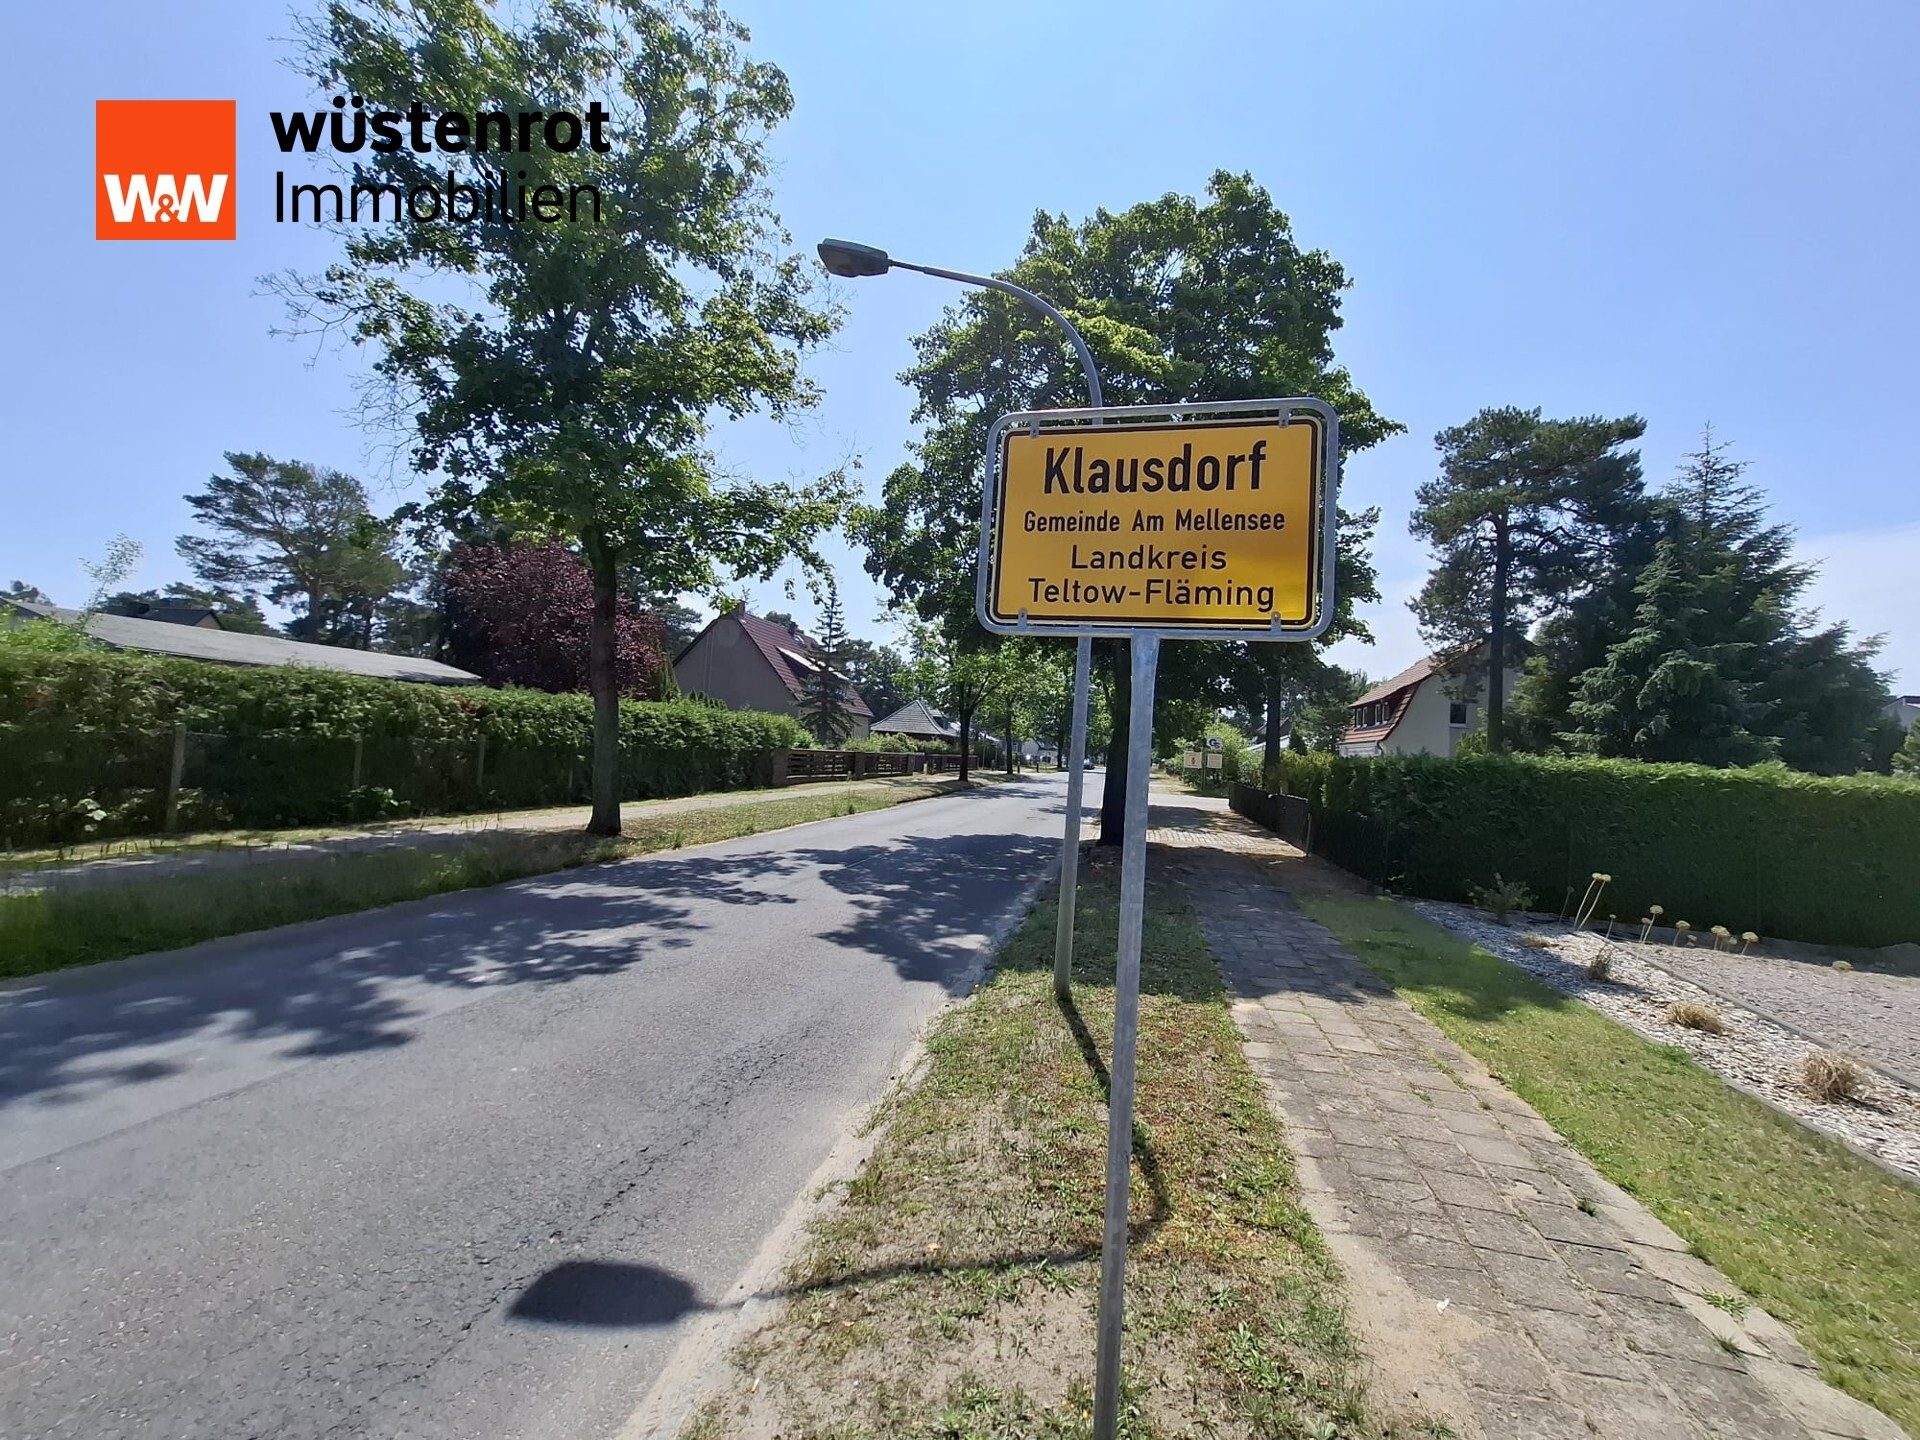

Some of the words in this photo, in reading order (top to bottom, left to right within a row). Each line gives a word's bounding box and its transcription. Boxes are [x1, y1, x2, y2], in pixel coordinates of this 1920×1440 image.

[1044, 441, 1267, 494] Klausdorf
[1024, 509, 1120, 533] Gemeinde
[1132, 509, 1164, 532] Am
[1175, 507, 1286, 531] Mellensee
[1071, 543, 1227, 571] Landkreis
[1028, 577, 1275, 613] Teltow-Fläming
